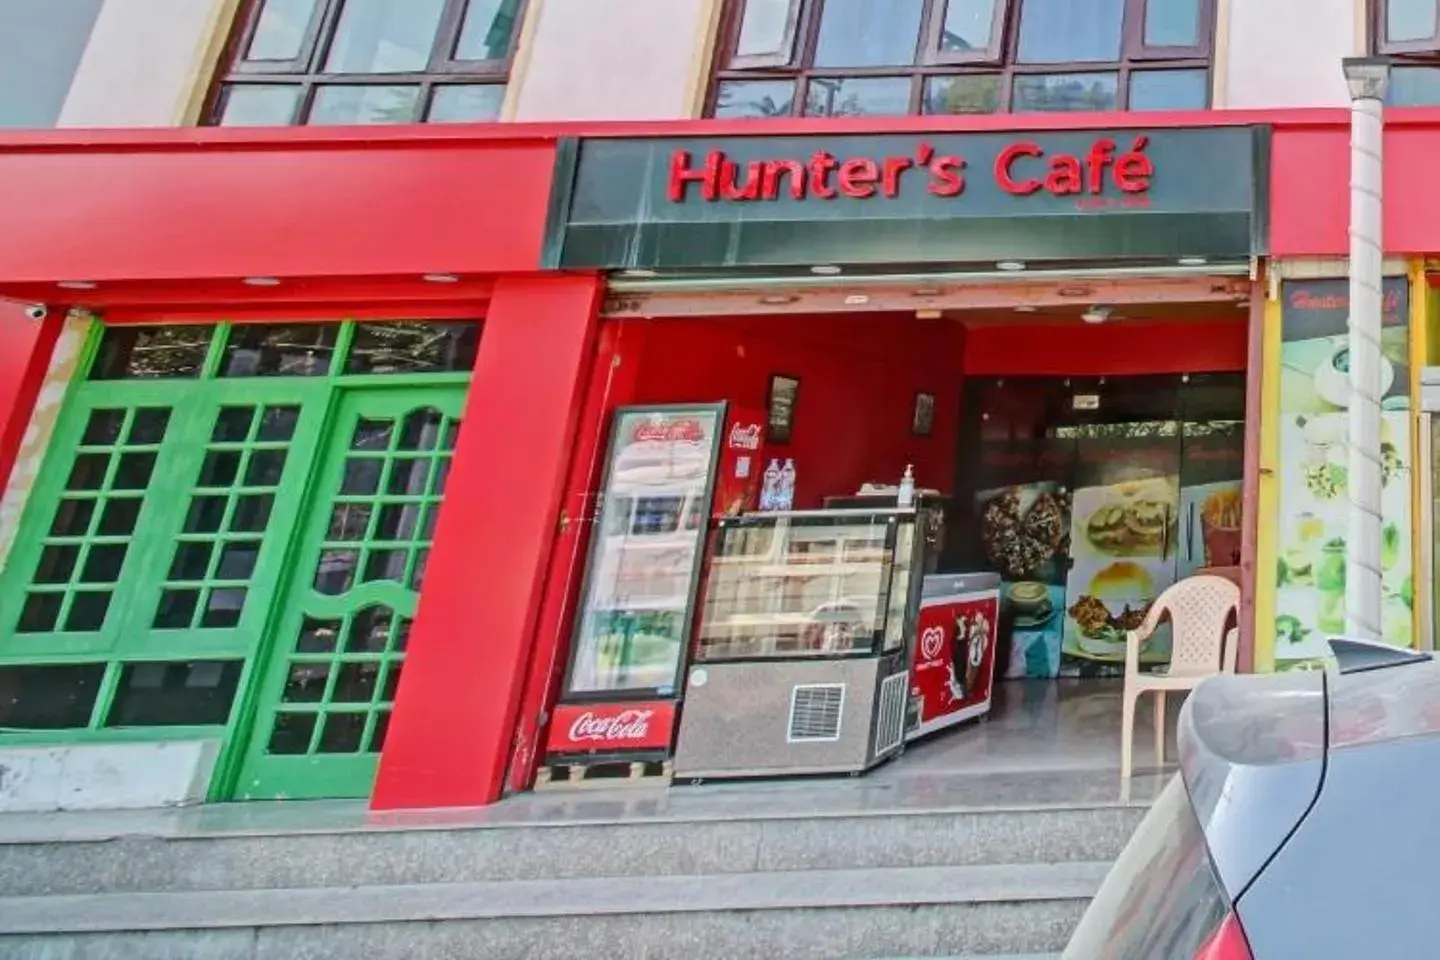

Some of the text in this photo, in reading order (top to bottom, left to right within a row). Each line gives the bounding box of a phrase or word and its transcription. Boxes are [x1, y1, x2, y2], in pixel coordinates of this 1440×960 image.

[667, 134, 1154, 202] Hunter's Café
[568, 709, 654, 742] Coca-Cola
